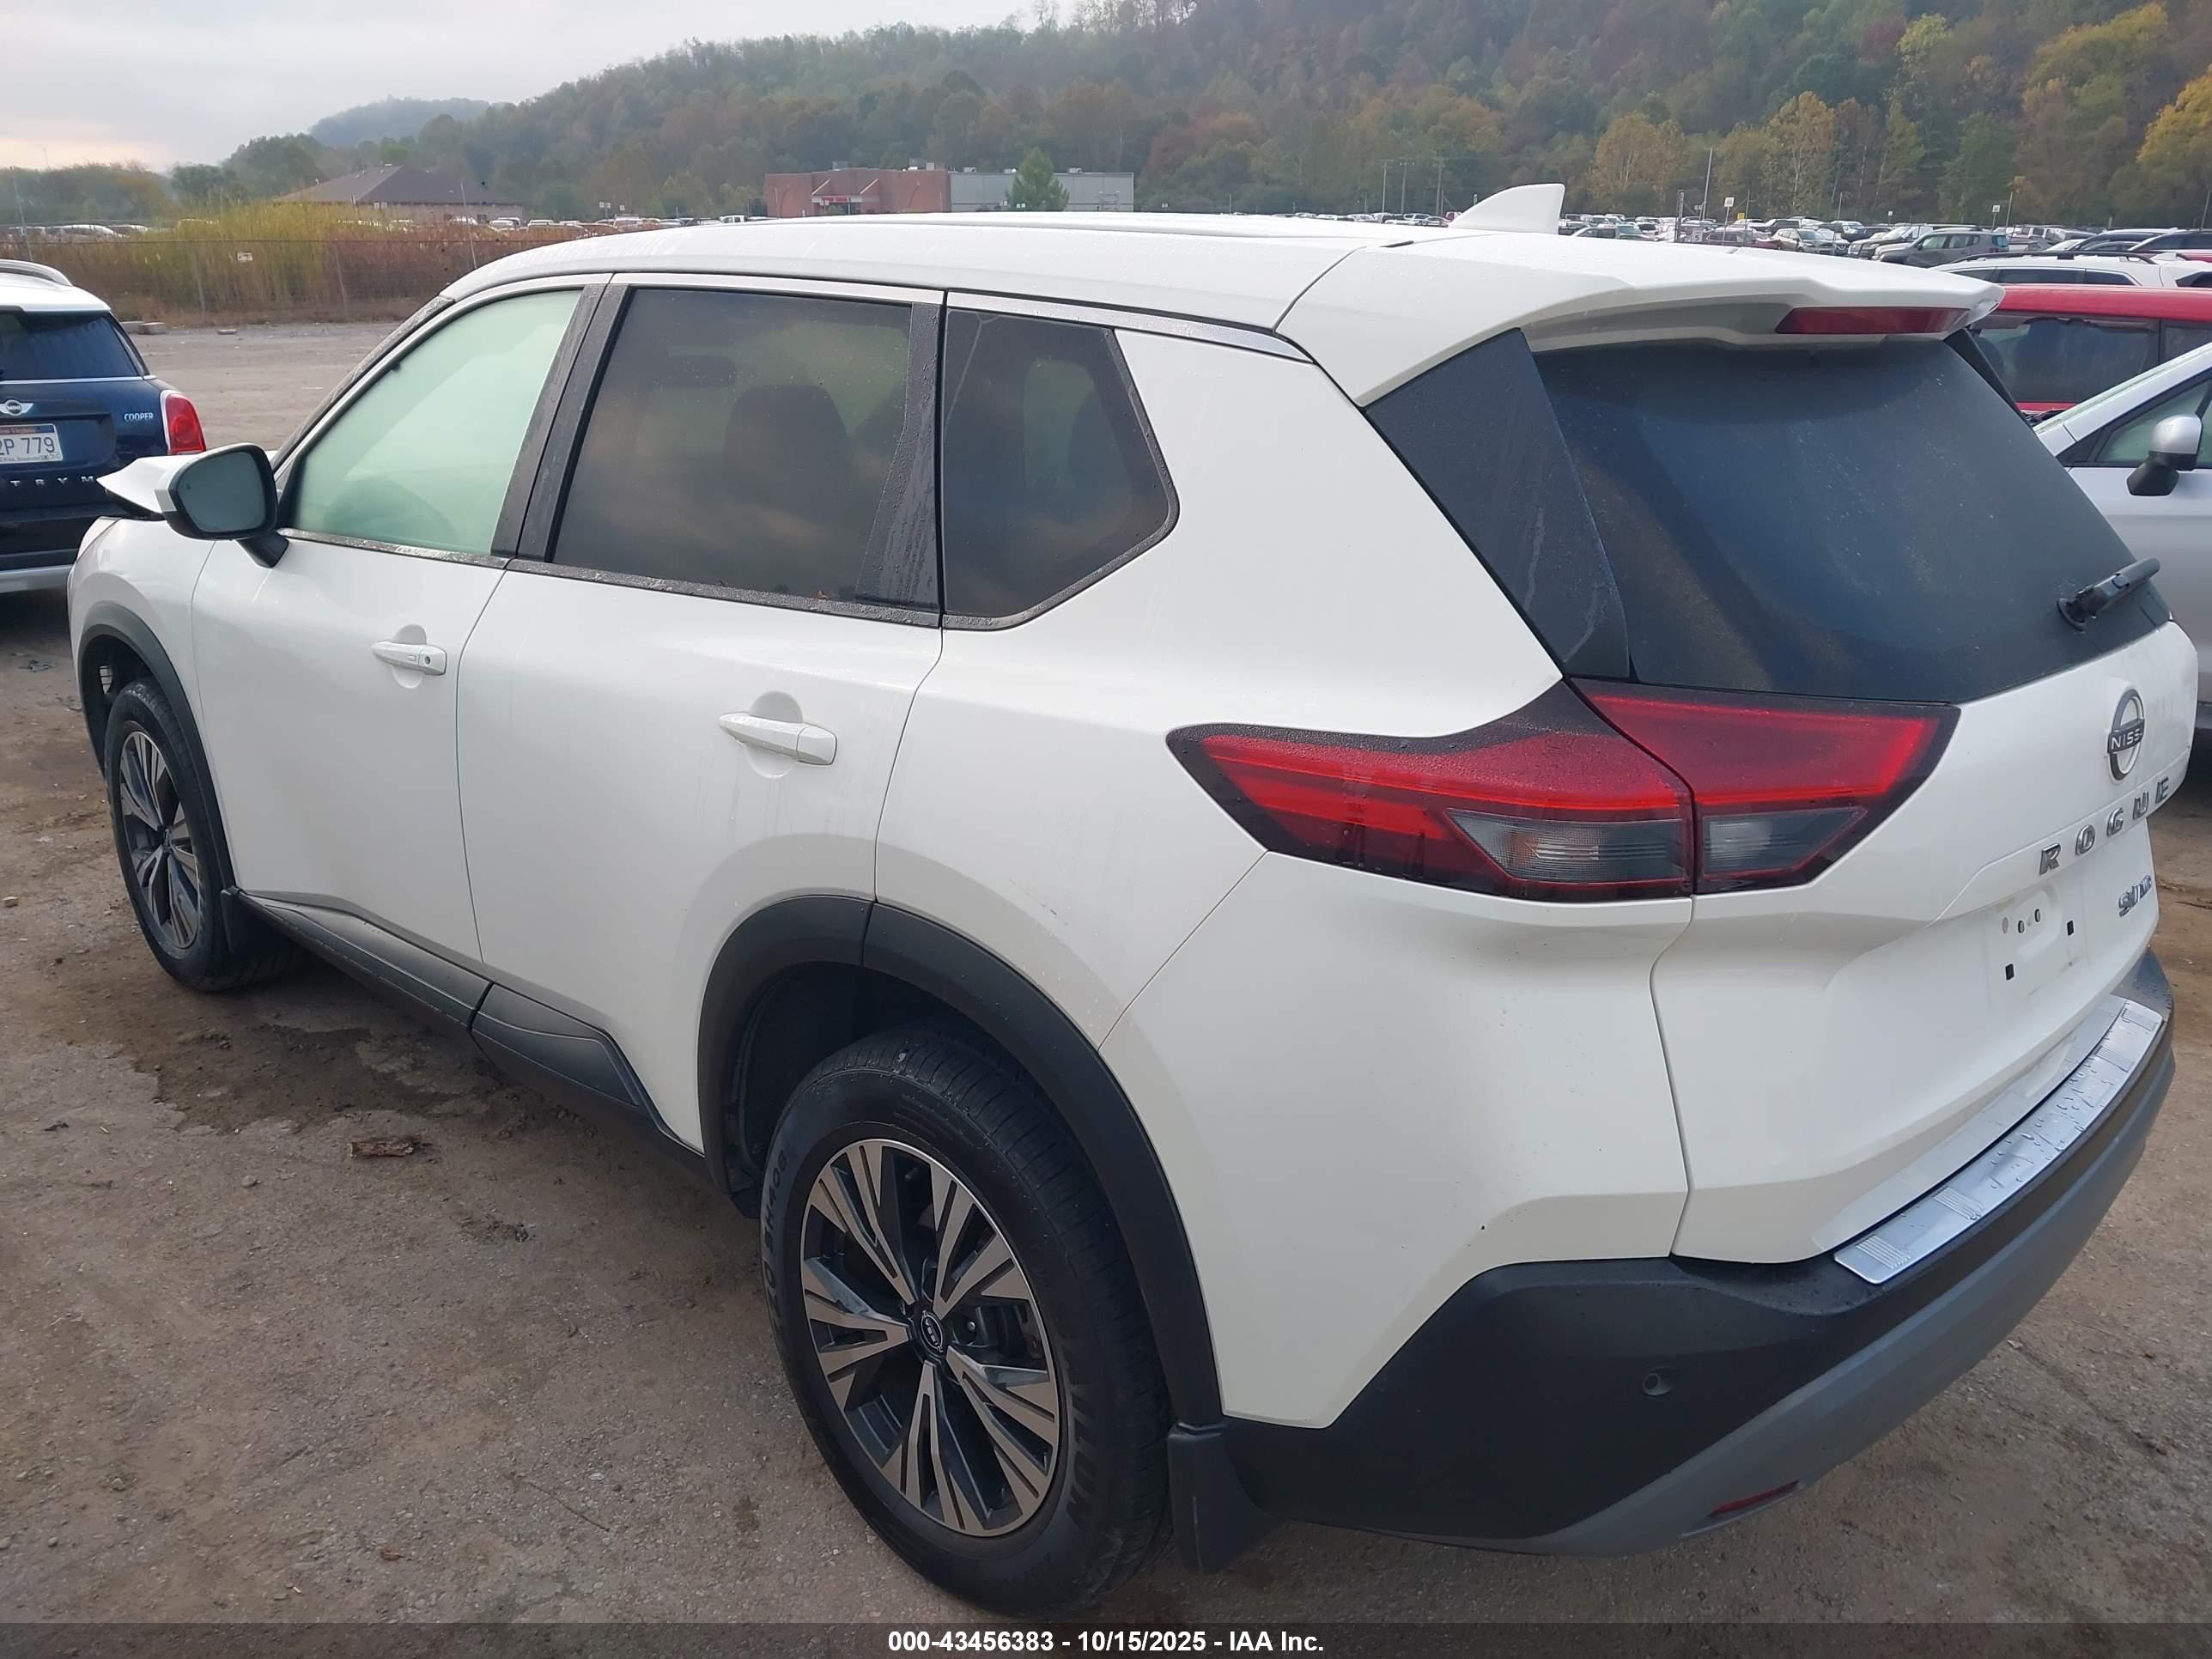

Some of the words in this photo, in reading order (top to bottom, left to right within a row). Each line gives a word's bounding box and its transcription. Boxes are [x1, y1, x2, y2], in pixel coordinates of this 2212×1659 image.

[124, 412, 155, 422] COOPER
[21, 436, 56, 454] 779
[2039, 776, 2169, 876] ROGUE
